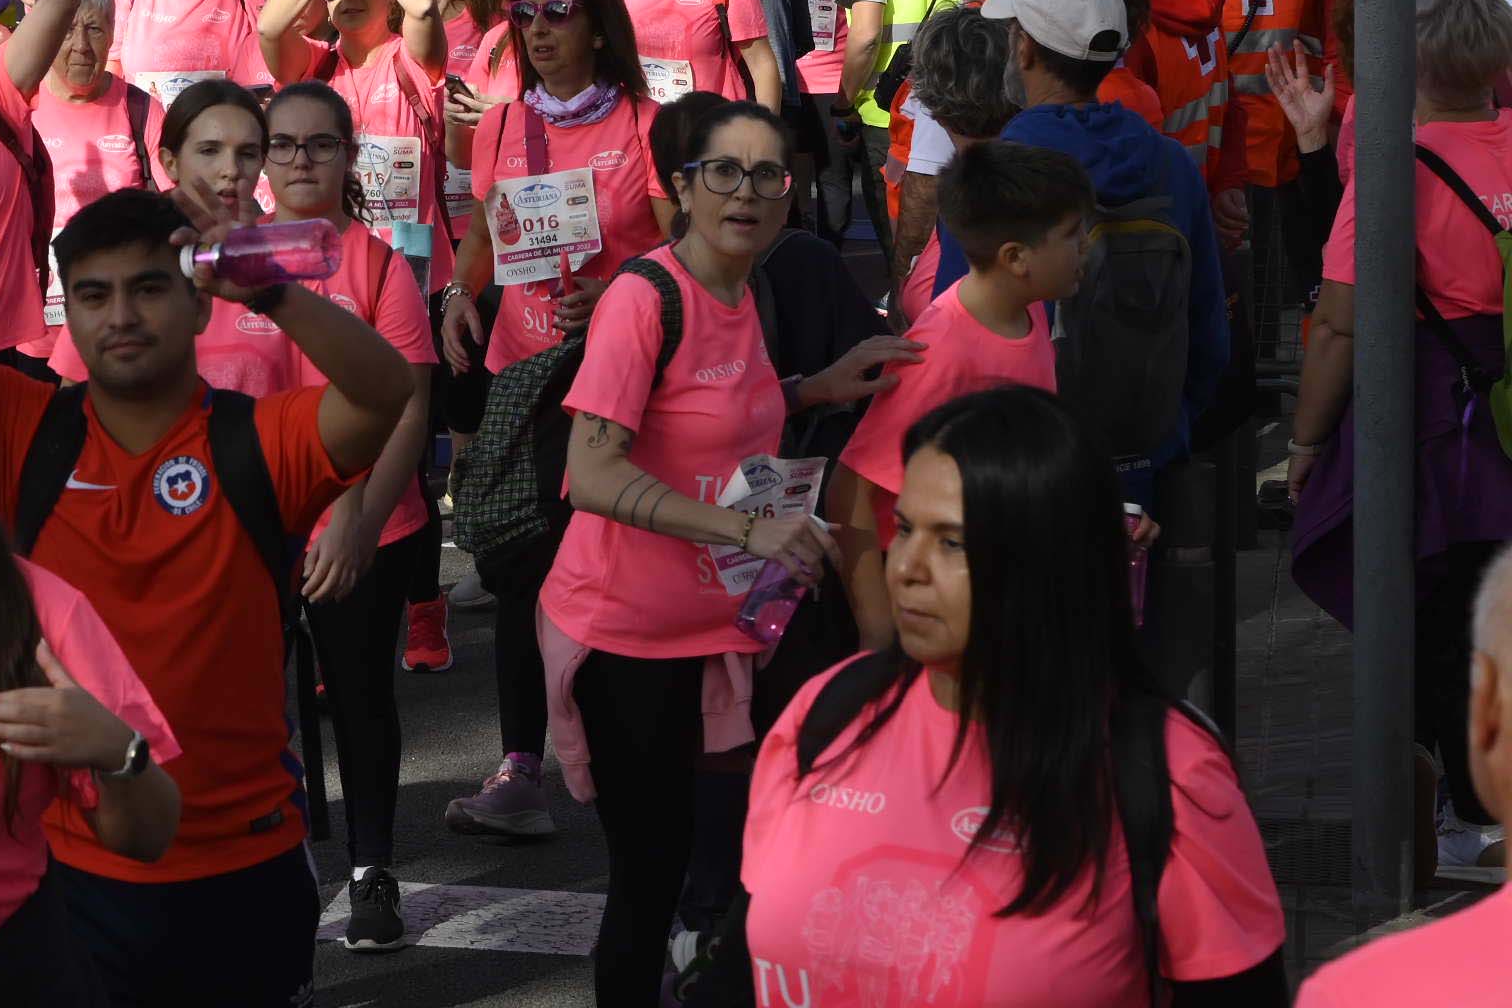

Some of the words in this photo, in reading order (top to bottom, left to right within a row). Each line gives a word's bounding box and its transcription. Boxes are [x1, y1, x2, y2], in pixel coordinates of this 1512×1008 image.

[564, 182, 587, 191] SUMA
[516, 192, 559, 205] ASTURIANA
[522, 214, 560, 233] 016
[528, 235, 559, 247] 31494
[507, 251, 533, 262] CARRERA
[506, 266, 537, 278] OYSHO
[695, 359, 747, 384] OYSHO
[810, 783, 887, 815] OYSHO
[753, 958, 811, 1008] TU
